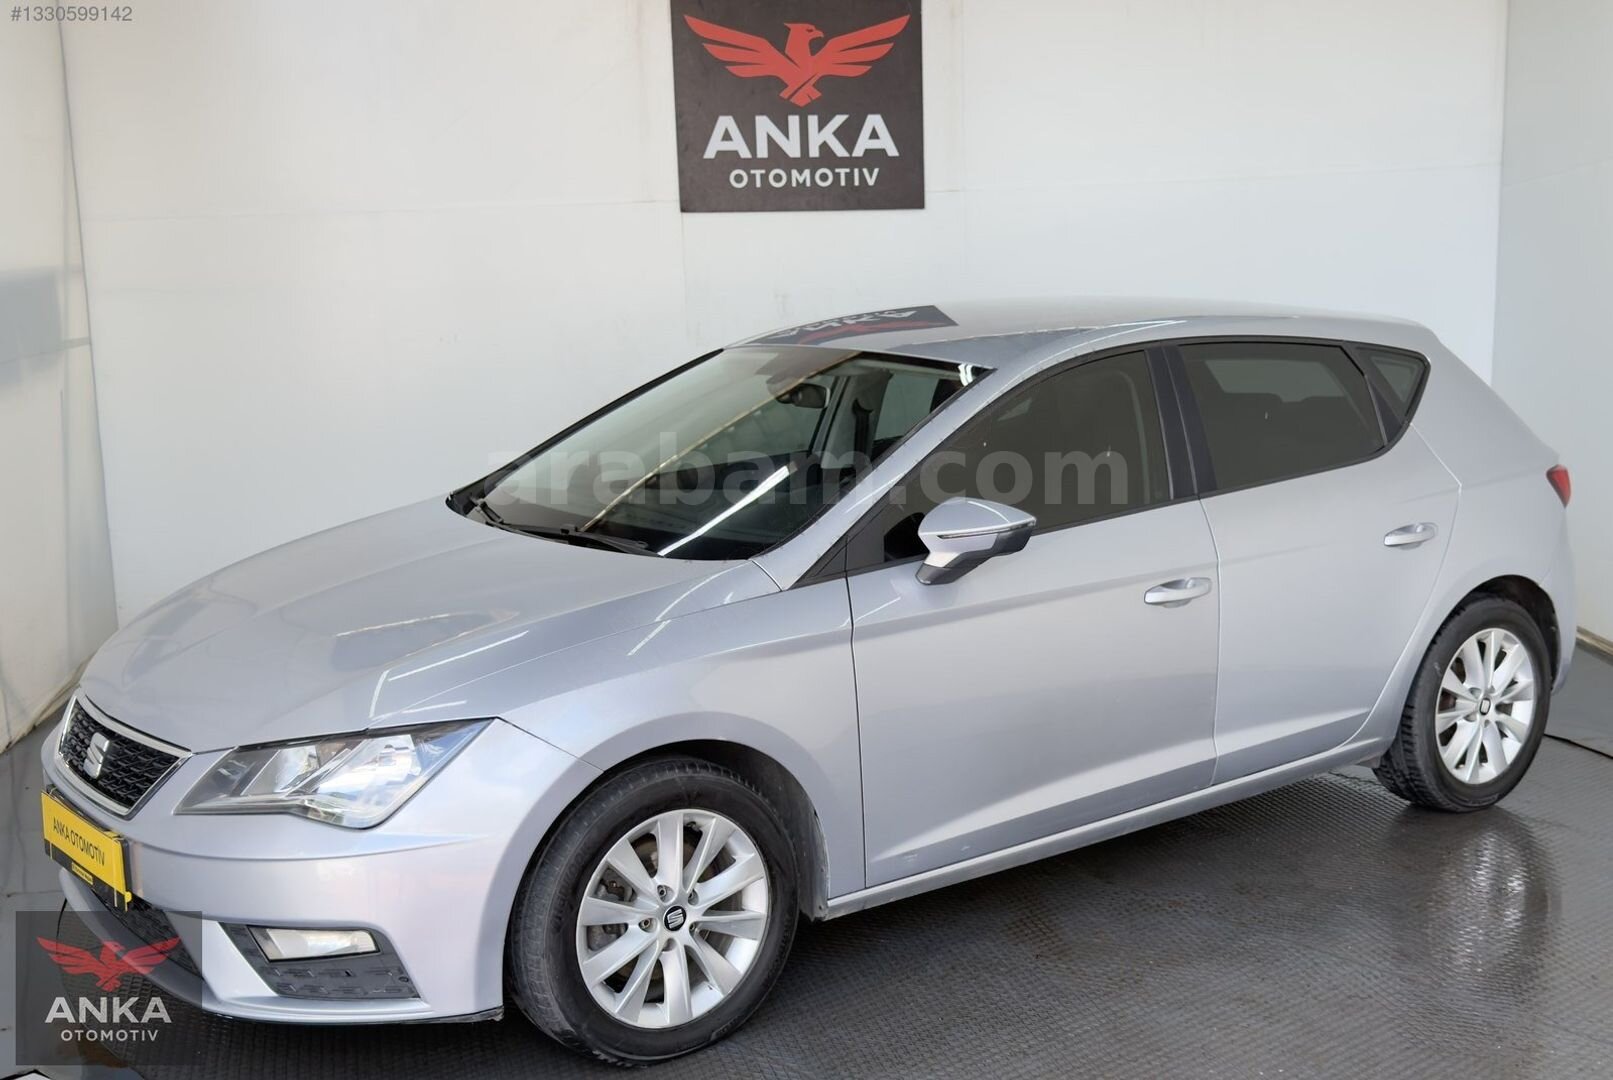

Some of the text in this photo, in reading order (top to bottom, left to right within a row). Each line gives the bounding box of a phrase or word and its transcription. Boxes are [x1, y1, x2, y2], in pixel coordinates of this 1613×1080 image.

[702, 113, 900, 160] ANKA
[729, 167, 880, 189] OTOMOTIV
[53, 817, 70, 841] ANKA
